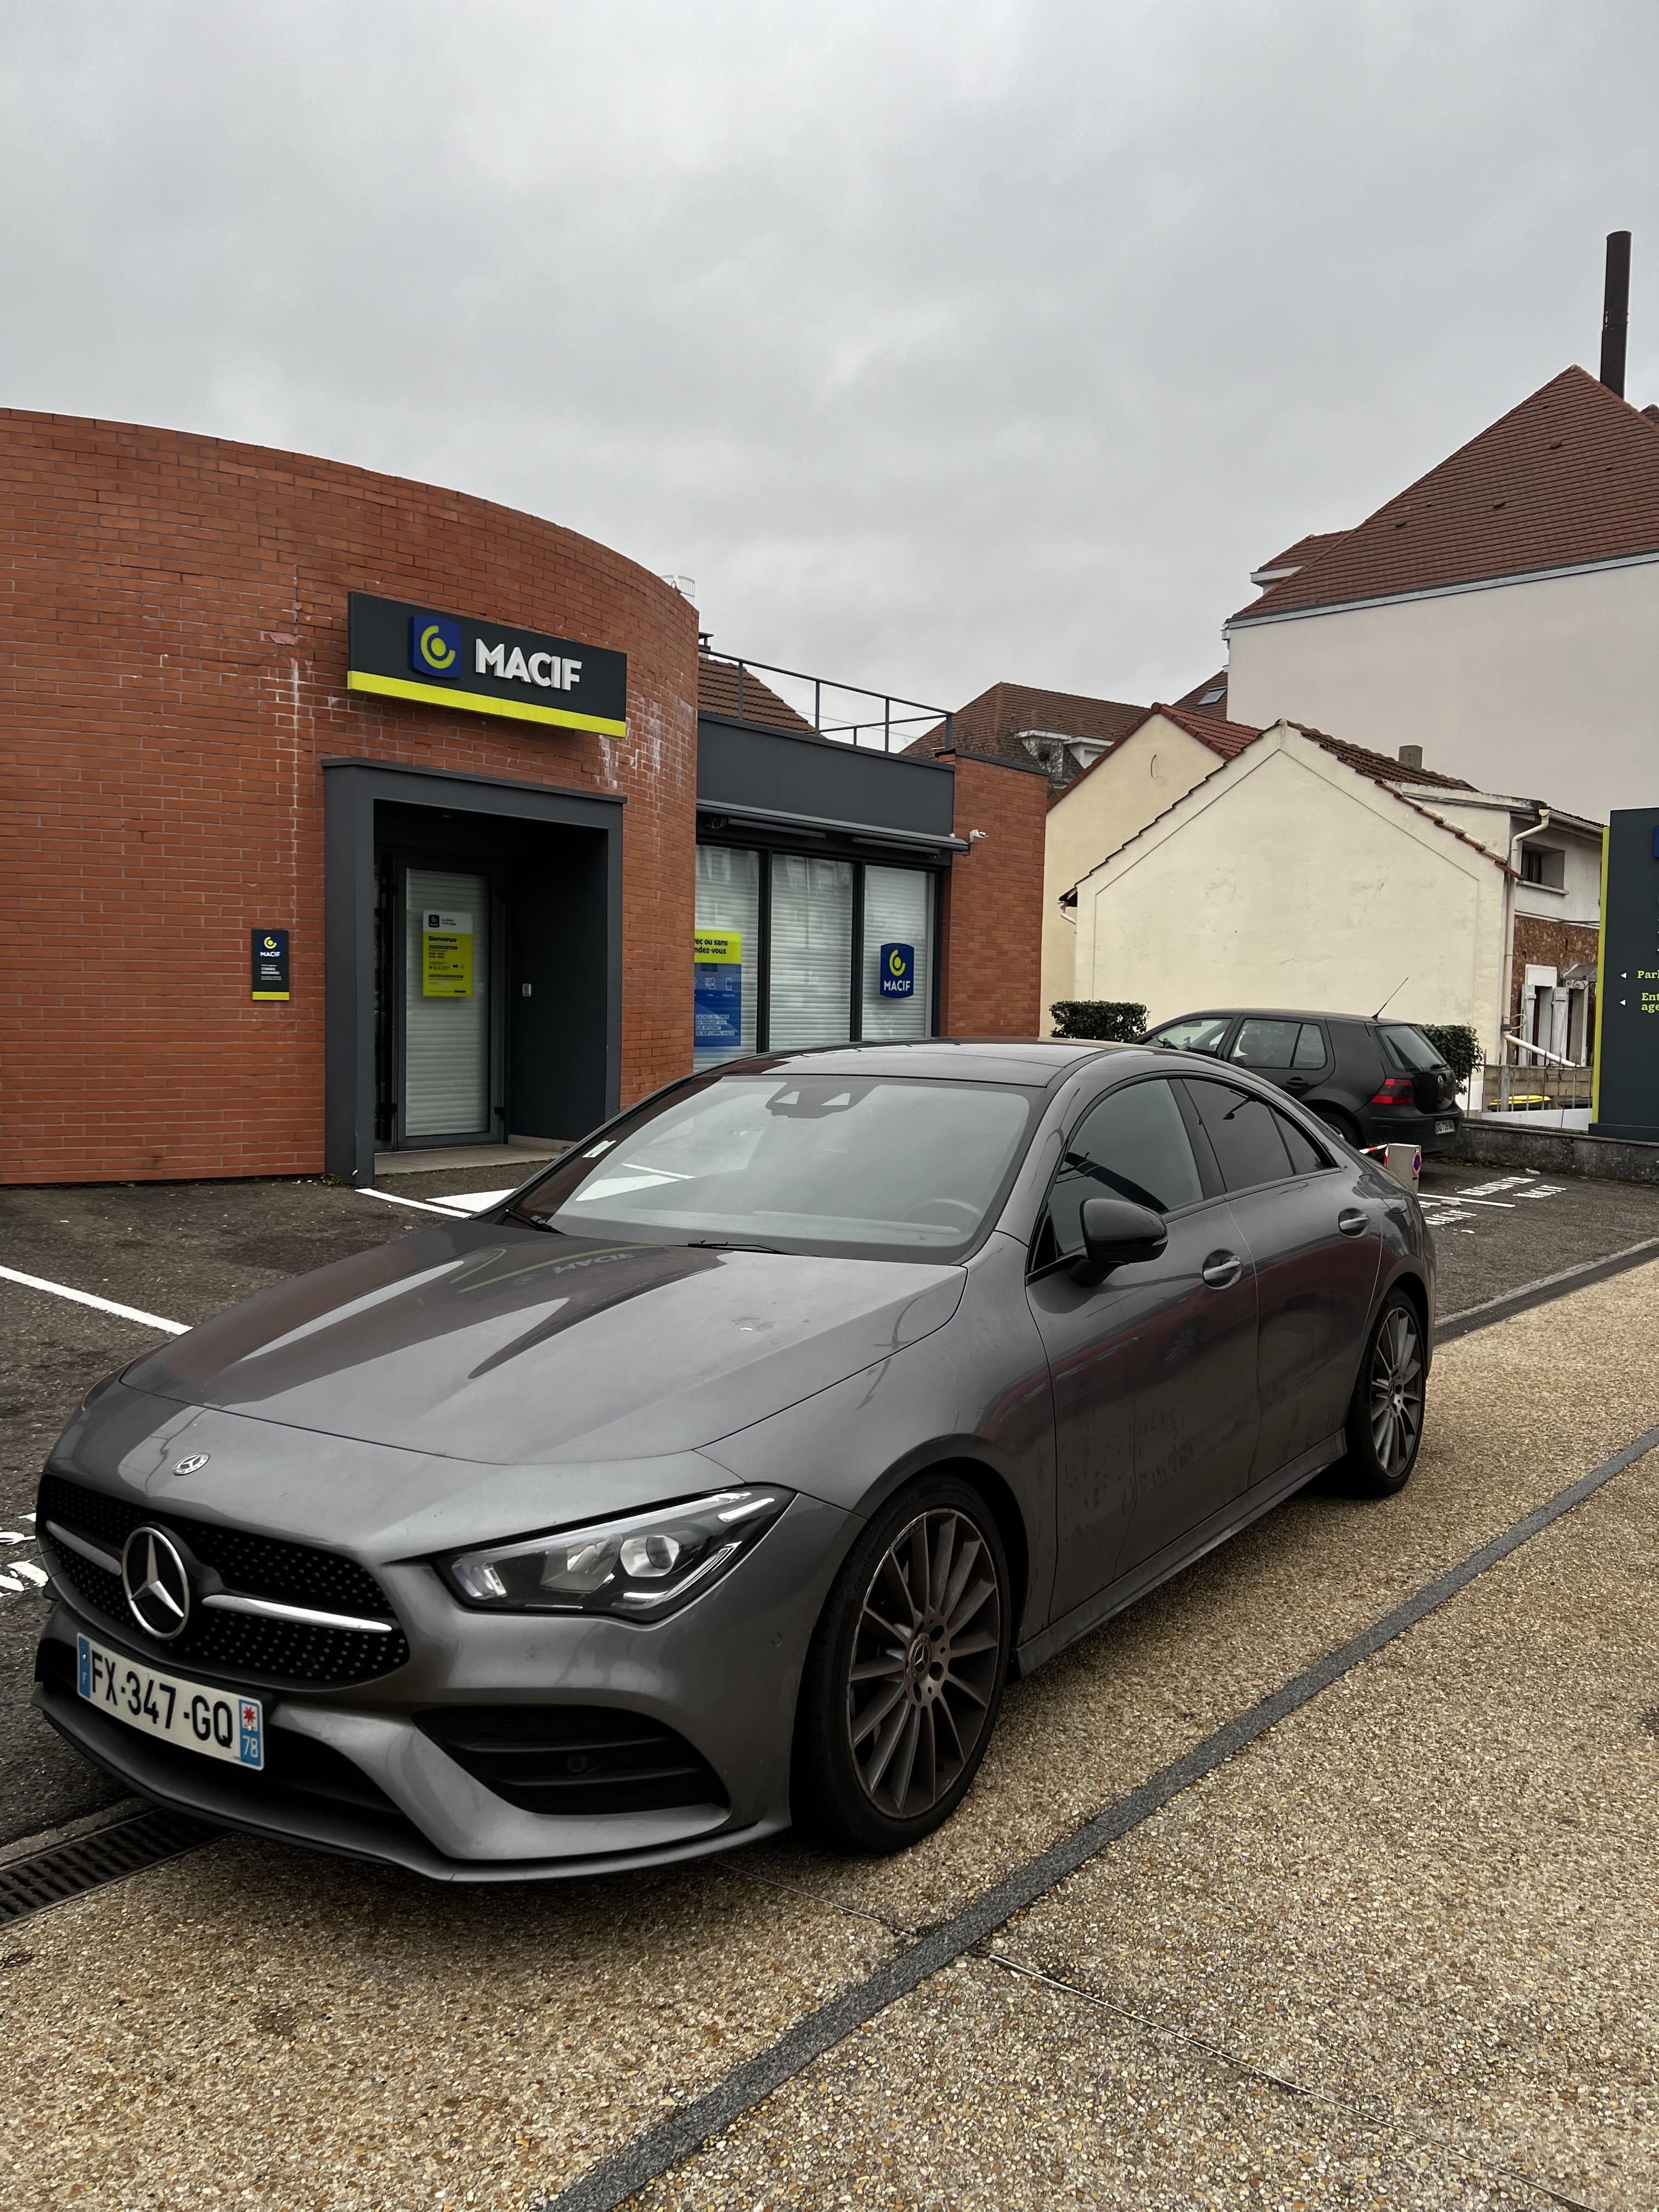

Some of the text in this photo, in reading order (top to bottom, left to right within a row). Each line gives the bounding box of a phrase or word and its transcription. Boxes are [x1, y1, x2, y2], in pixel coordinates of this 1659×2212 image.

[475, 638, 582, 691] MACIF
[1637, 970, 1659, 979] Par
[884, 980, 911, 991] MACIF
[1641, 1004, 1659, 1013] age
[92, 1649, 233, 1749] FX-347-GQ
[242, 1735, 258, 1758] 78
